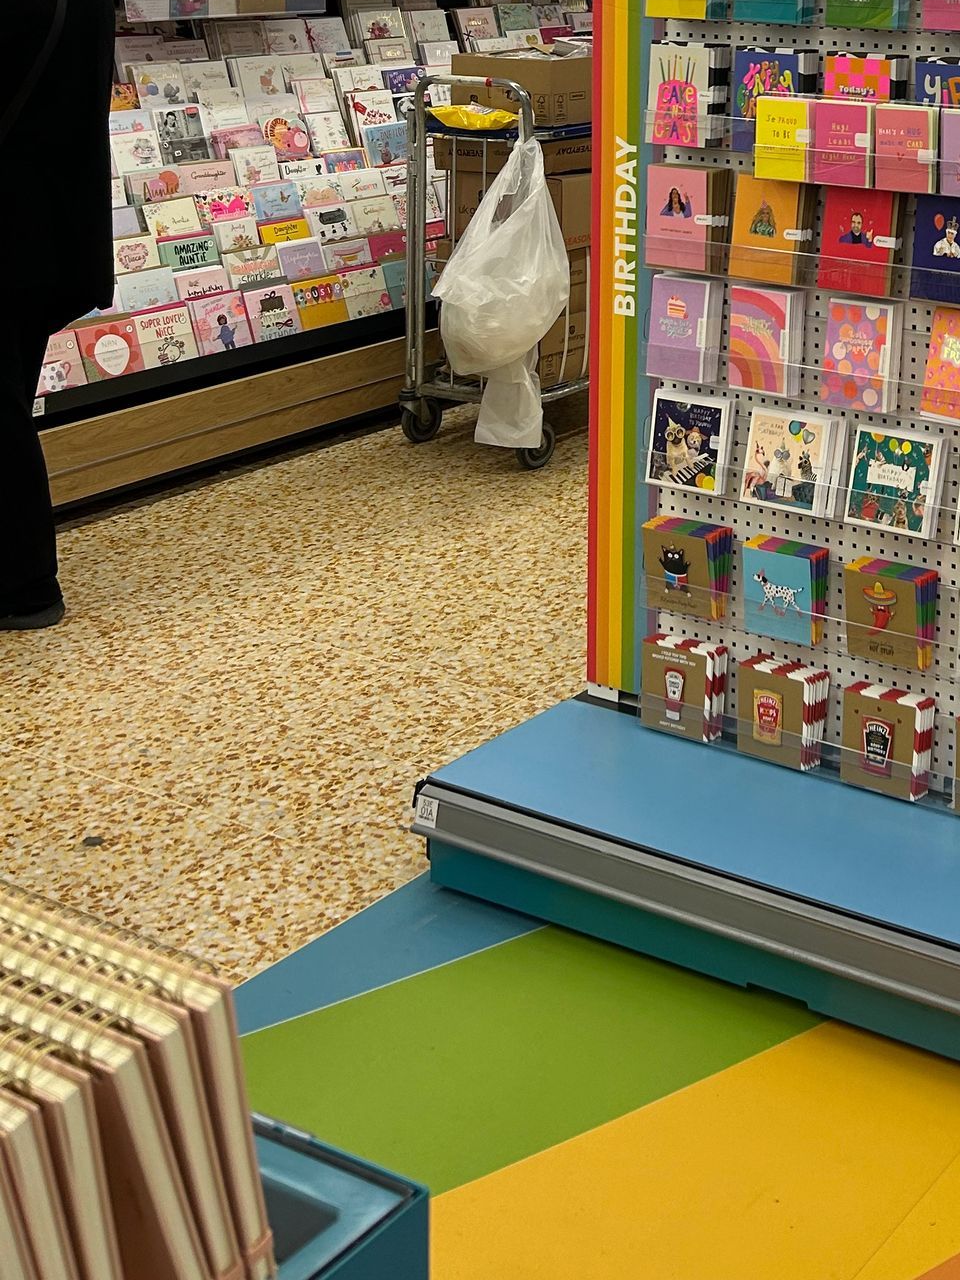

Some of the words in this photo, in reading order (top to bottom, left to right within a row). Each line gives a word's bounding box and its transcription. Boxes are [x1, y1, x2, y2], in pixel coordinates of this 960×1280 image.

[839, 85, 876, 97] Today's
[772, 130, 781, 138] TO
[782, 130, 791, 139] BE
[907, 140, 924, 150] CARD
[448, 149, 484, 158] EVERYDY
[613, 136, 638, 317] BIRTHDAY
[140, 319, 161, 330] SUPER
[760, 695, 776, 707] HEINZ
[869, 723, 887, 735] HEINZ
